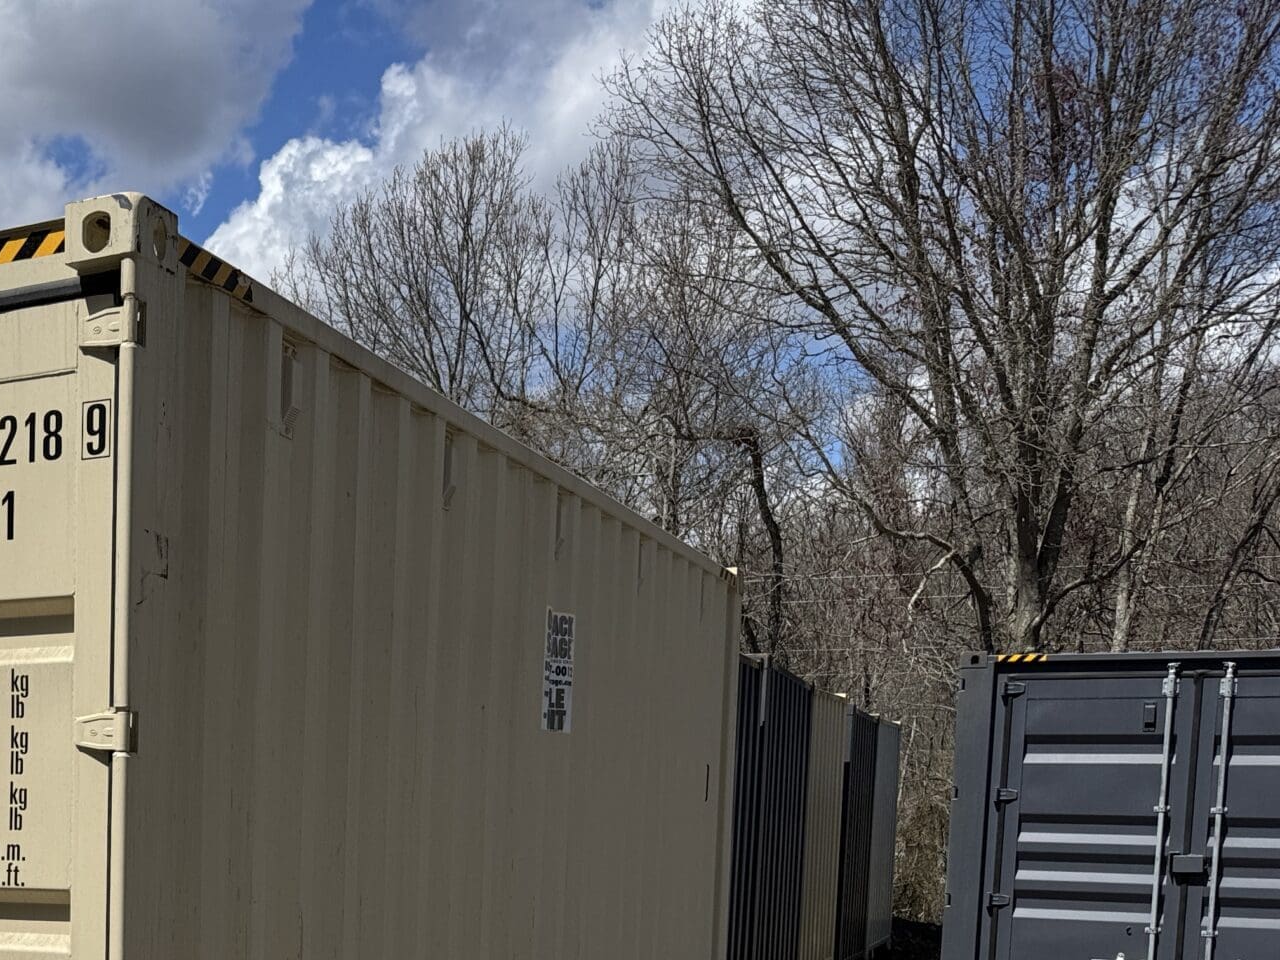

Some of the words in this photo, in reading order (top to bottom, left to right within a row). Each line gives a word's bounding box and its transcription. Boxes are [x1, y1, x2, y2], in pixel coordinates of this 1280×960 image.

[86, 403, 107, 456] 9
[11, 668, 29, 697] kg
[10, 695, 25, 719] lb
[11, 725, 29, 754] kg
[10, 751, 24, 775] lb
[9, 781, 28, 810] kg
[9, 806, 23, 831] lb
